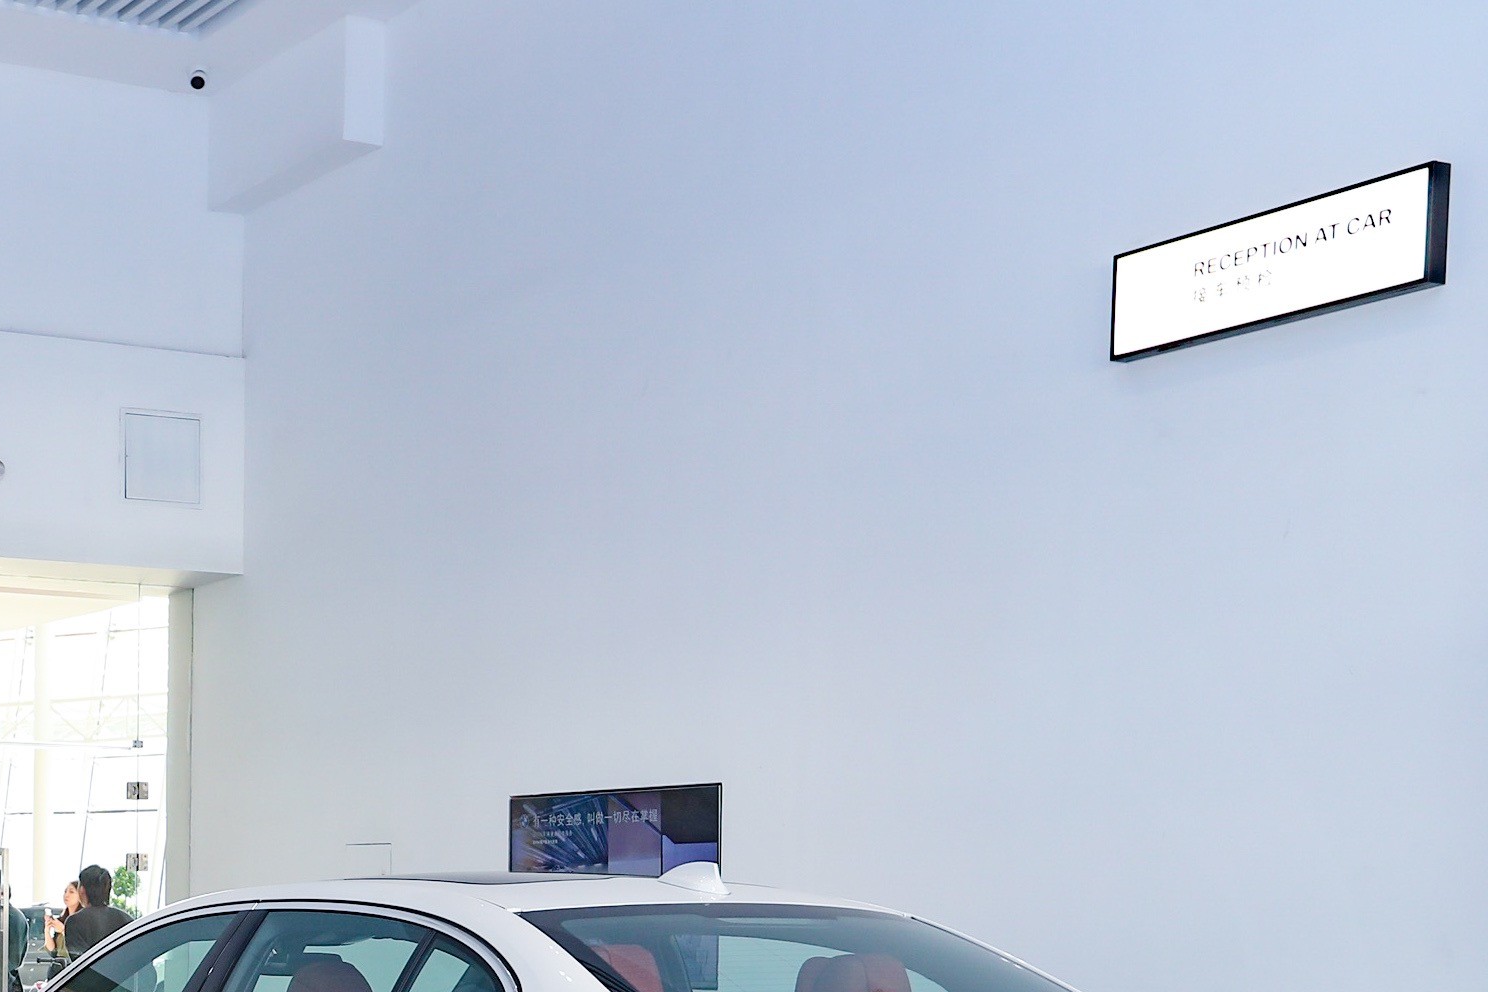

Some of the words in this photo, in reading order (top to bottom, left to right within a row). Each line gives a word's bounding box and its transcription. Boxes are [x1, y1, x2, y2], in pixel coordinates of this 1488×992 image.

[1194, 233, 1308, 276] RECEPTION
[1315, 223, 1340, 244] AT
[1347, 208, 1392, 235] CAR
